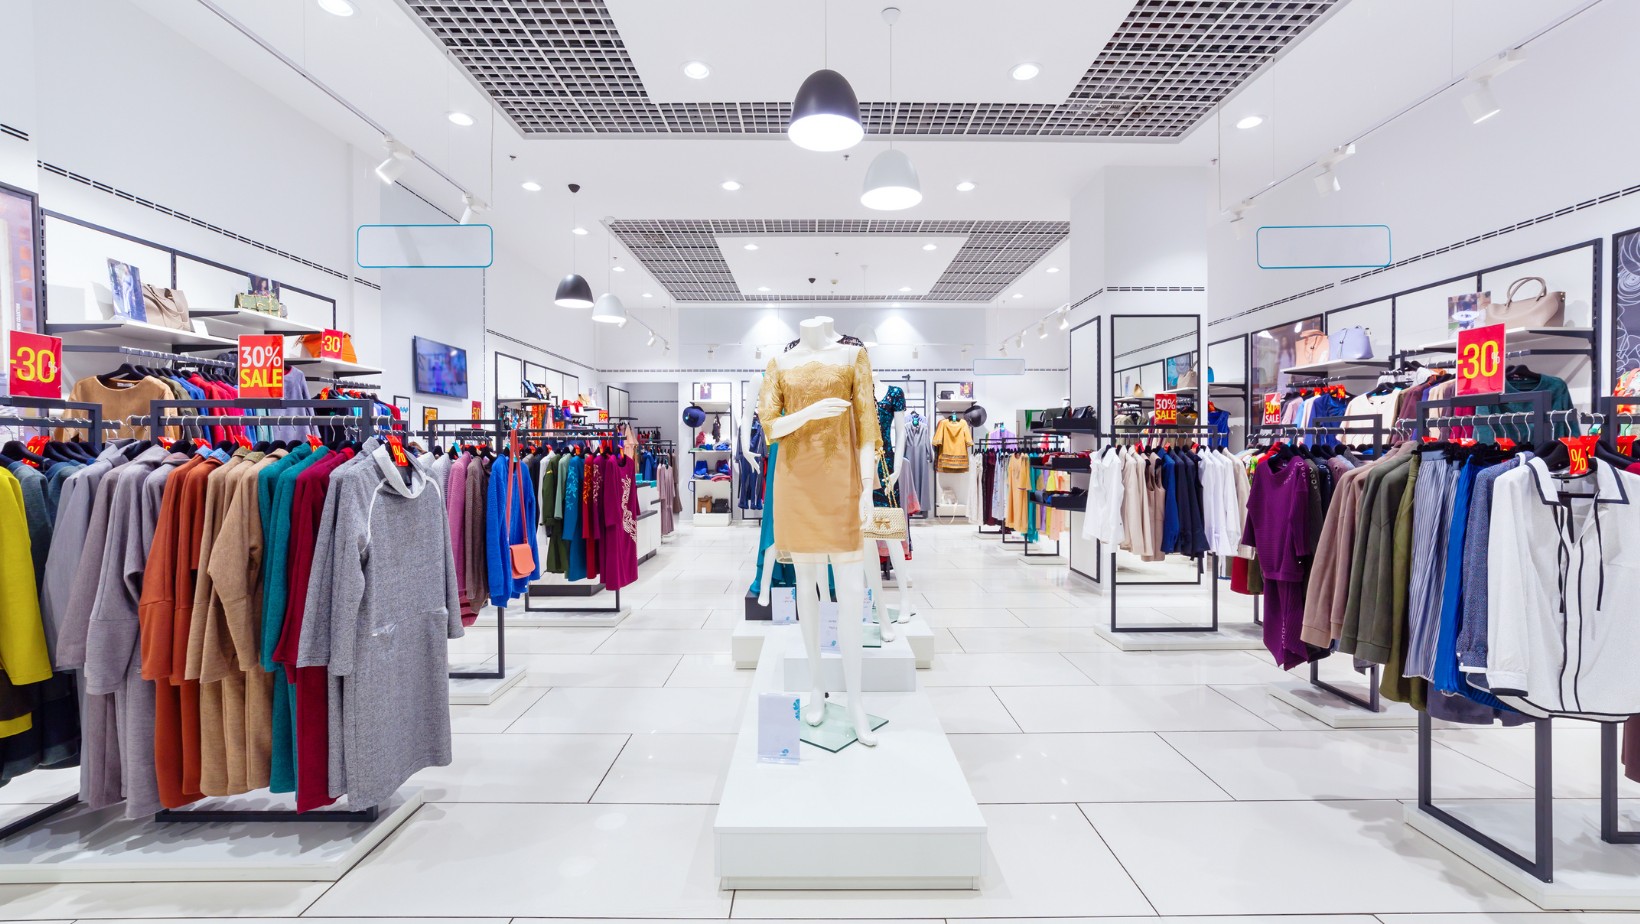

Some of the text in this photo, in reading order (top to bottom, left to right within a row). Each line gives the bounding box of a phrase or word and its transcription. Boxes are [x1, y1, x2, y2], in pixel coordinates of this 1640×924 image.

[241, 345, 281, 367] 30%
[240, 368, 283, 388] SALE
[1156, 398, 1176, 410] 30%
[1155, 410, 1176, 420] SALE
[1265, 414, 1280, 424] SALE
